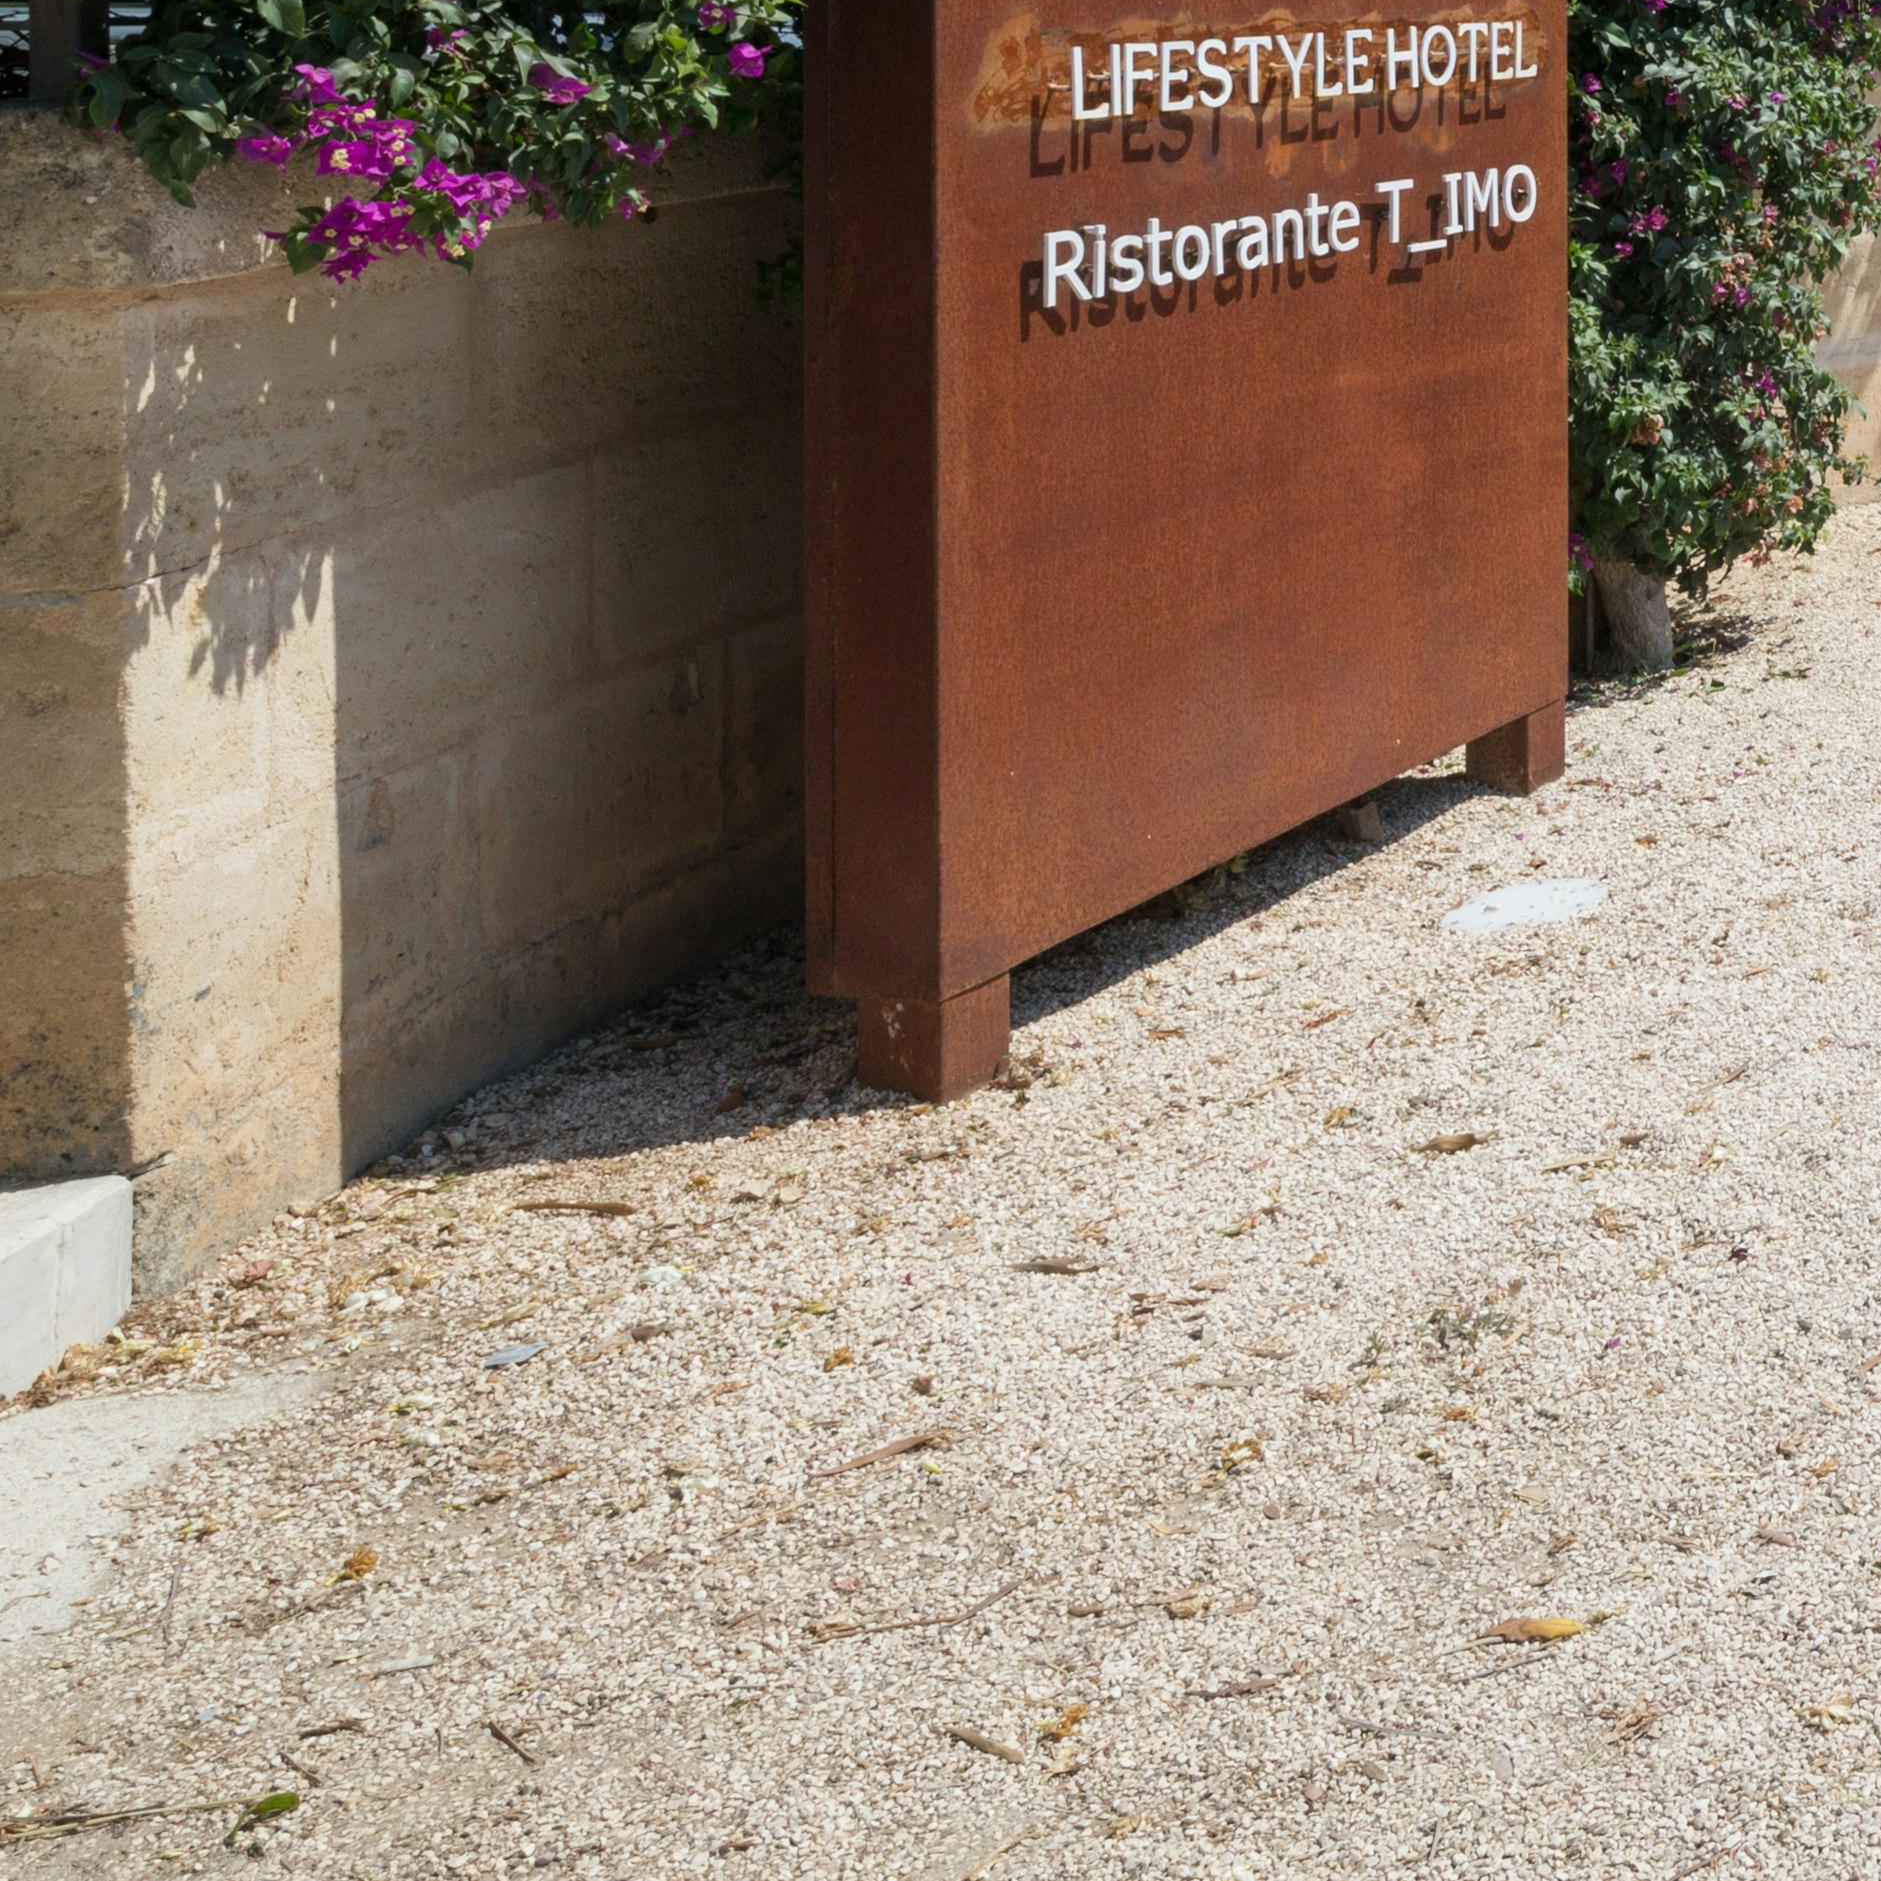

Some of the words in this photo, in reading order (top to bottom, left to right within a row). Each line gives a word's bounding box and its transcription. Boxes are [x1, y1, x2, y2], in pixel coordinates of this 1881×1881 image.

[1070, 27, 1376, 121] LIFESTYLE
[1386, 18, 1539, 92] HOTEL
[1043, 191, 1361, 310] Ristorante
[1375, 162, 1539, 255] T_IMO
